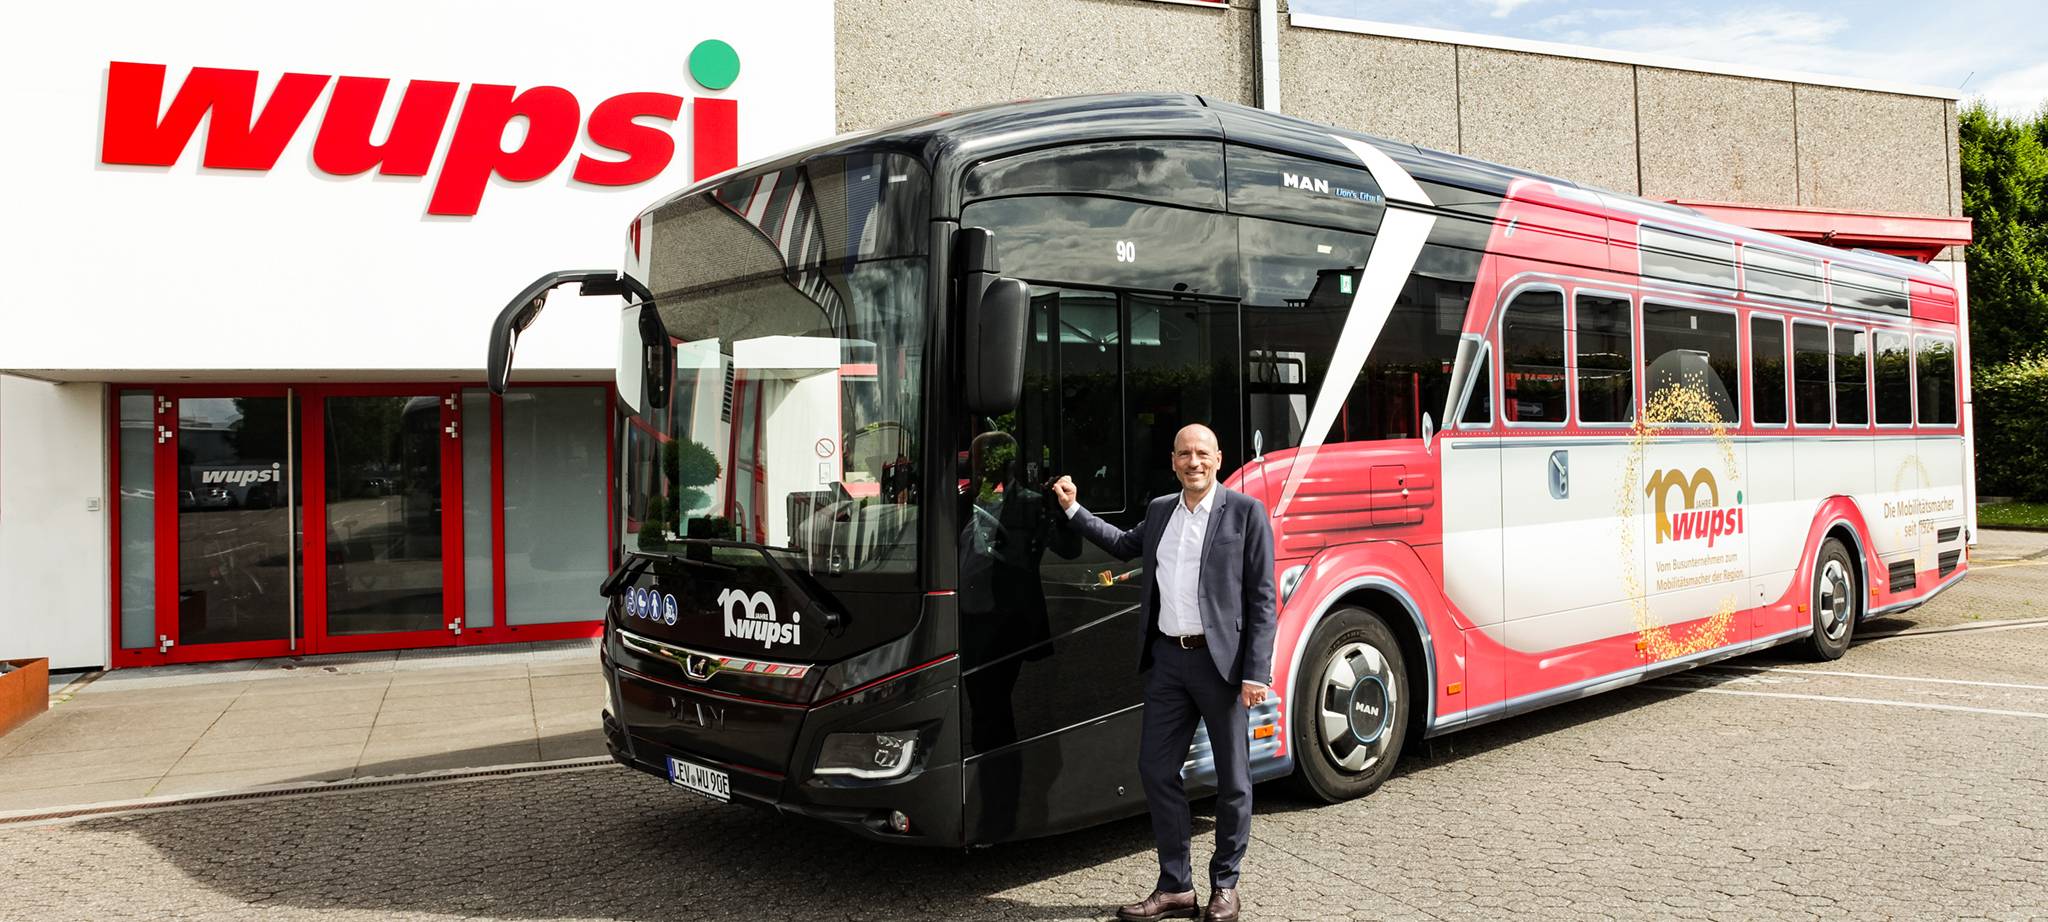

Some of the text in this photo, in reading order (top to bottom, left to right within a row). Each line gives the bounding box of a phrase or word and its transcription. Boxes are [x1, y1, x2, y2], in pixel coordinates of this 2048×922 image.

[101, 39, 741, 217] wupsi
[1283, 172, 1329, 194] MAN
[1116, 240, 1136, 263] 90
[202, 462, 280, 487] wupsi
[1672, 490, 1744, 548] wupsi
[1884, 502, 1896, 519] Die
[1656, 553, 1738, 573] Vom Busunternehmen zum
[1713, 570, 1723, 583] der
[1723, 568, 1745, 583] Region
[736, 611, 801, 649] wupsi
[1355, 701, 1379, 717] MAN
[672, 760, 690, 784] LEV
[696, 767, 709, 789] WU
